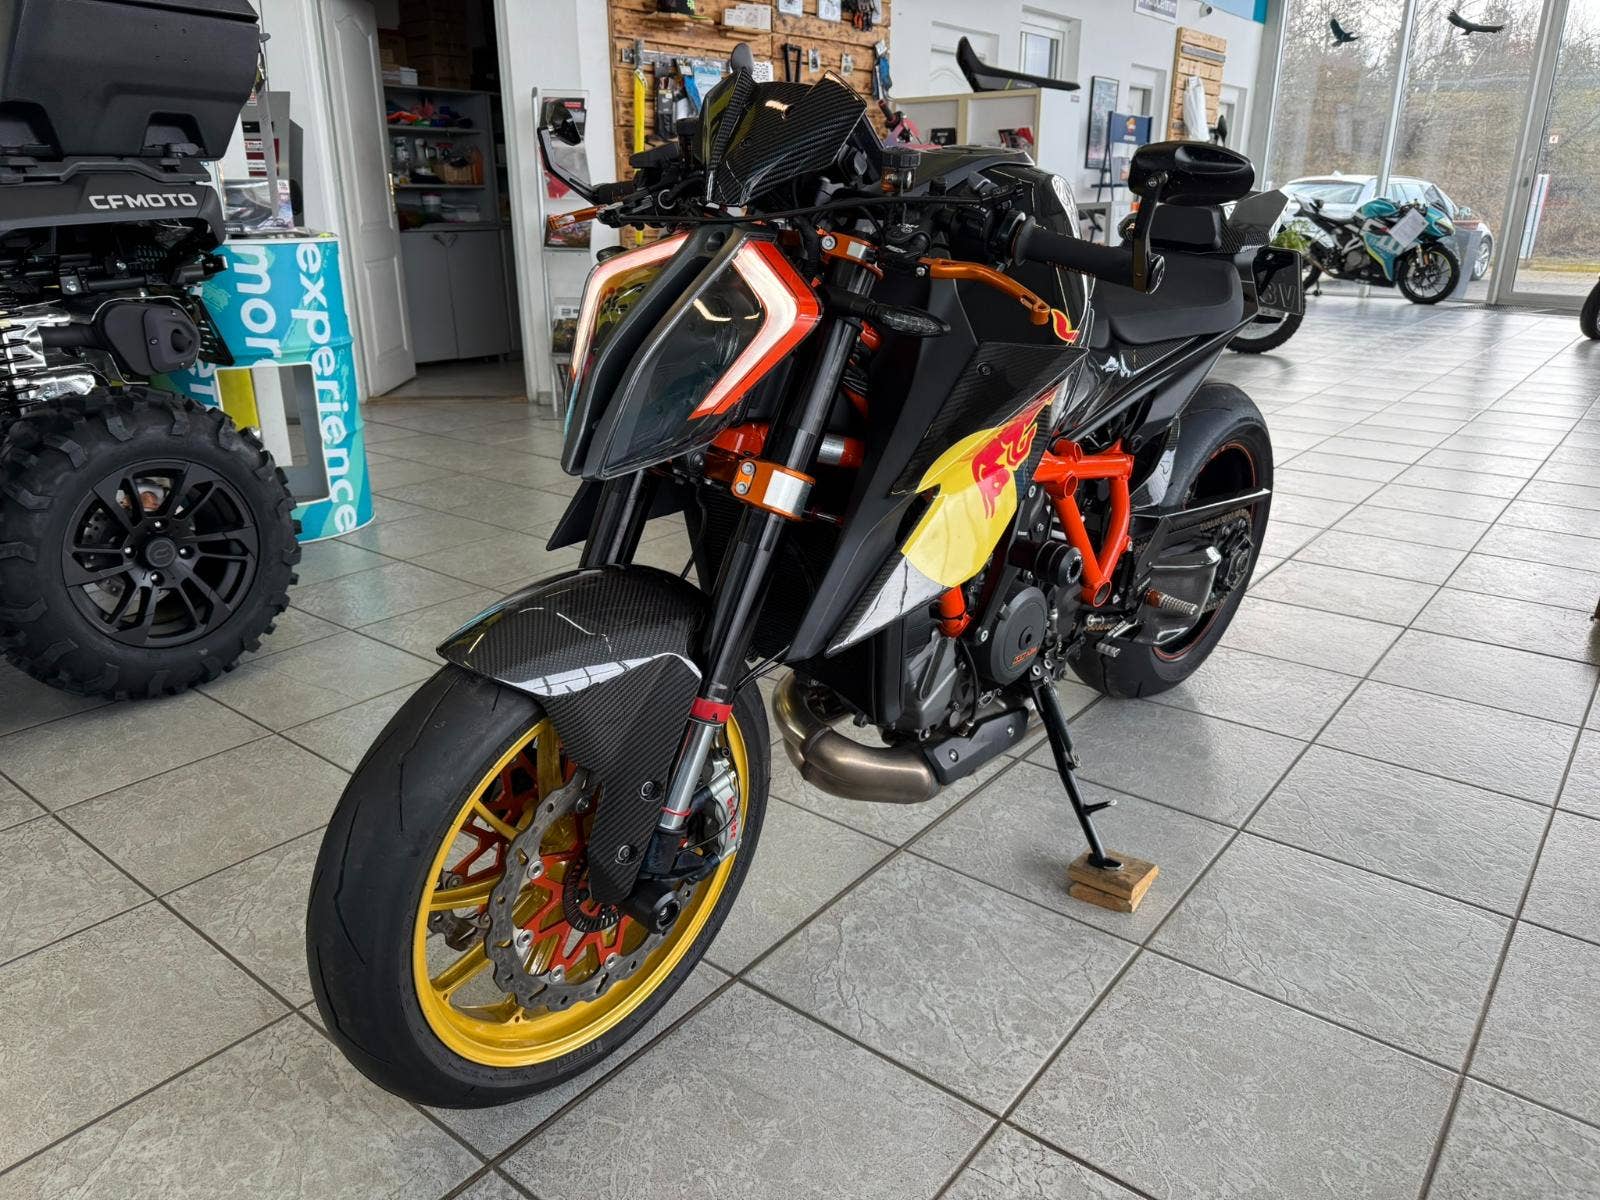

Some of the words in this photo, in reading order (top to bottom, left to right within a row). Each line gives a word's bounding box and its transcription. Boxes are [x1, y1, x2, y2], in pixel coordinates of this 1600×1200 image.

[88, 193, 198, 210] CFMOTO
[231, 245, 282, 366] mor
[291, 243, 357, 532] experience
